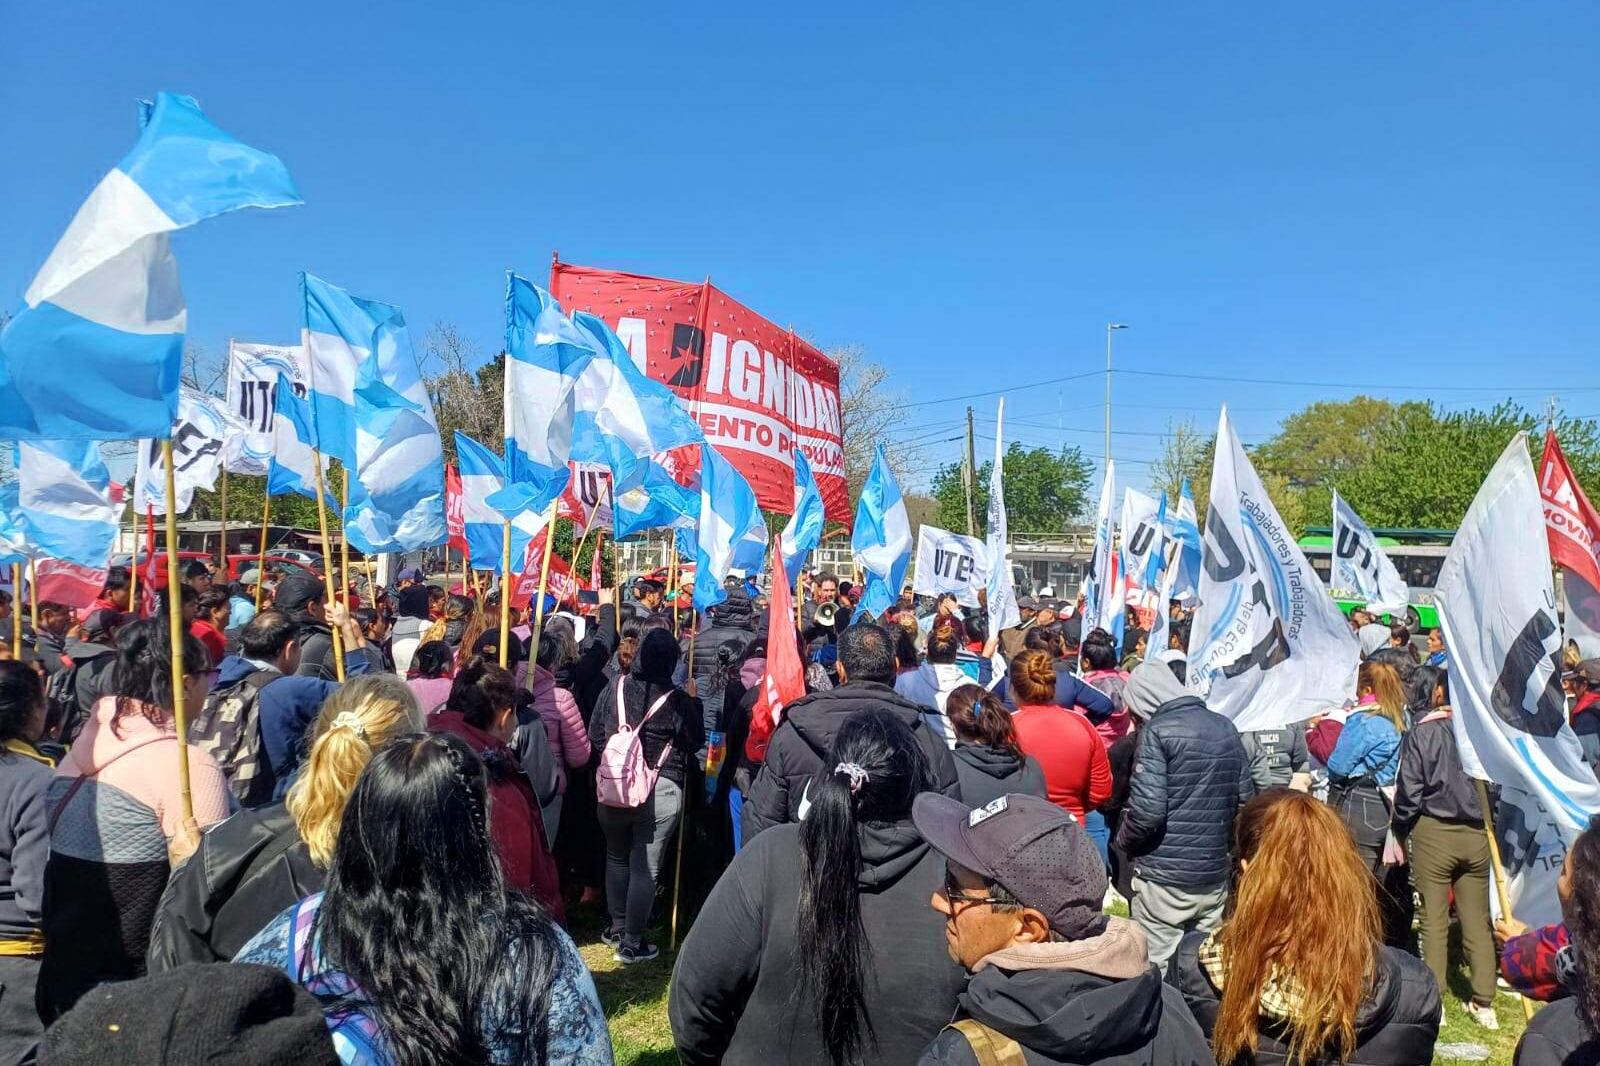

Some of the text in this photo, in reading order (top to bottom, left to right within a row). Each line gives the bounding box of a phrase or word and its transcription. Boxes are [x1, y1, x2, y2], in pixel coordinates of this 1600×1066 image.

[616, 316, 647, 376] A
[934, 549, 974, 584] UTEP
[1240, 490, 1308, 641] Trabajadores y Trabajadoras
